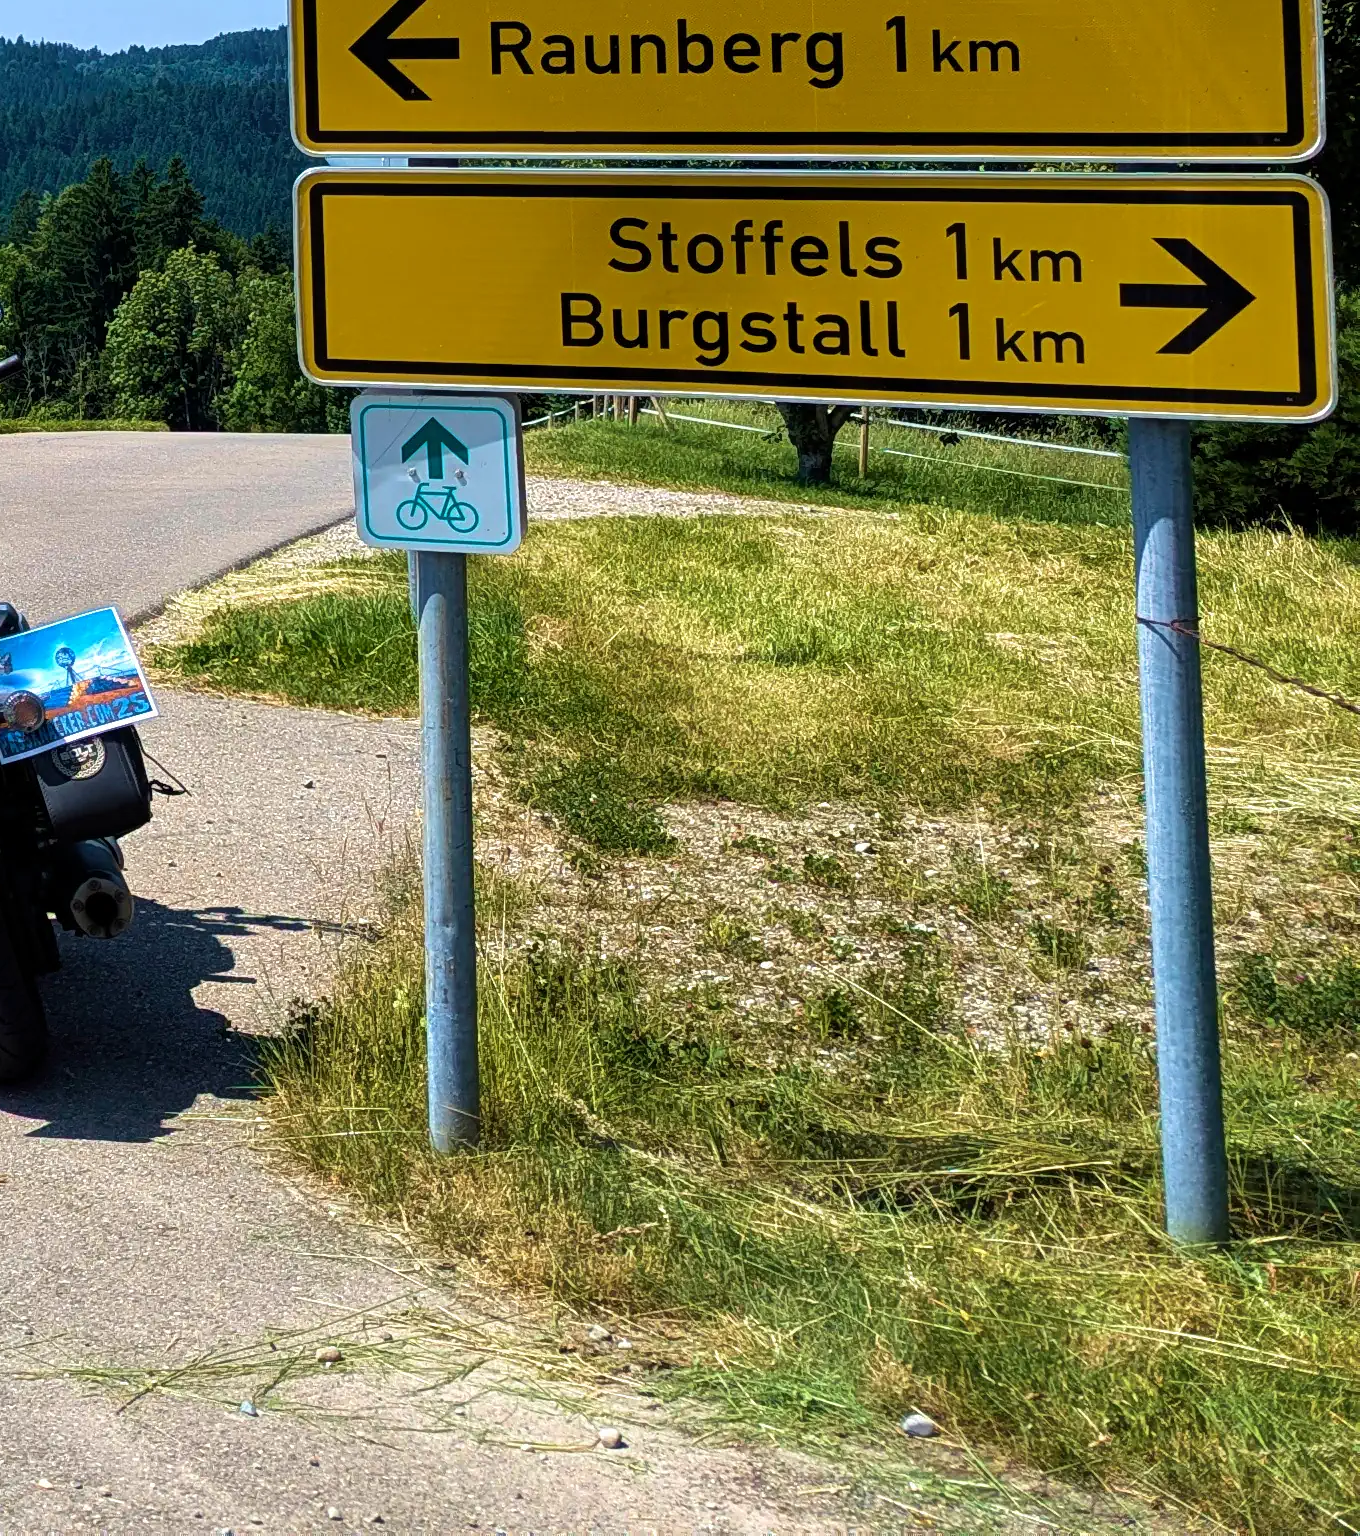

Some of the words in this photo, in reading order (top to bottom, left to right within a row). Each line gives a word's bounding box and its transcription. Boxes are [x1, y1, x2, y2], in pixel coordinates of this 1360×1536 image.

[490, 18, 845, 89] Raunberg
[885, 15, 908, 73] 1
[931, 28, 1021, 73] km
[607, 217, 904, 279] Stoffels
[945, 222, 968, 280] 1
[992, 237, 1083, 283] km
[560, 292, 907, 367] Burgstall
[948, 302, 971, 361] 1
[995, 317, 1086, 364] km
[112, 692, 149, 719] 25
